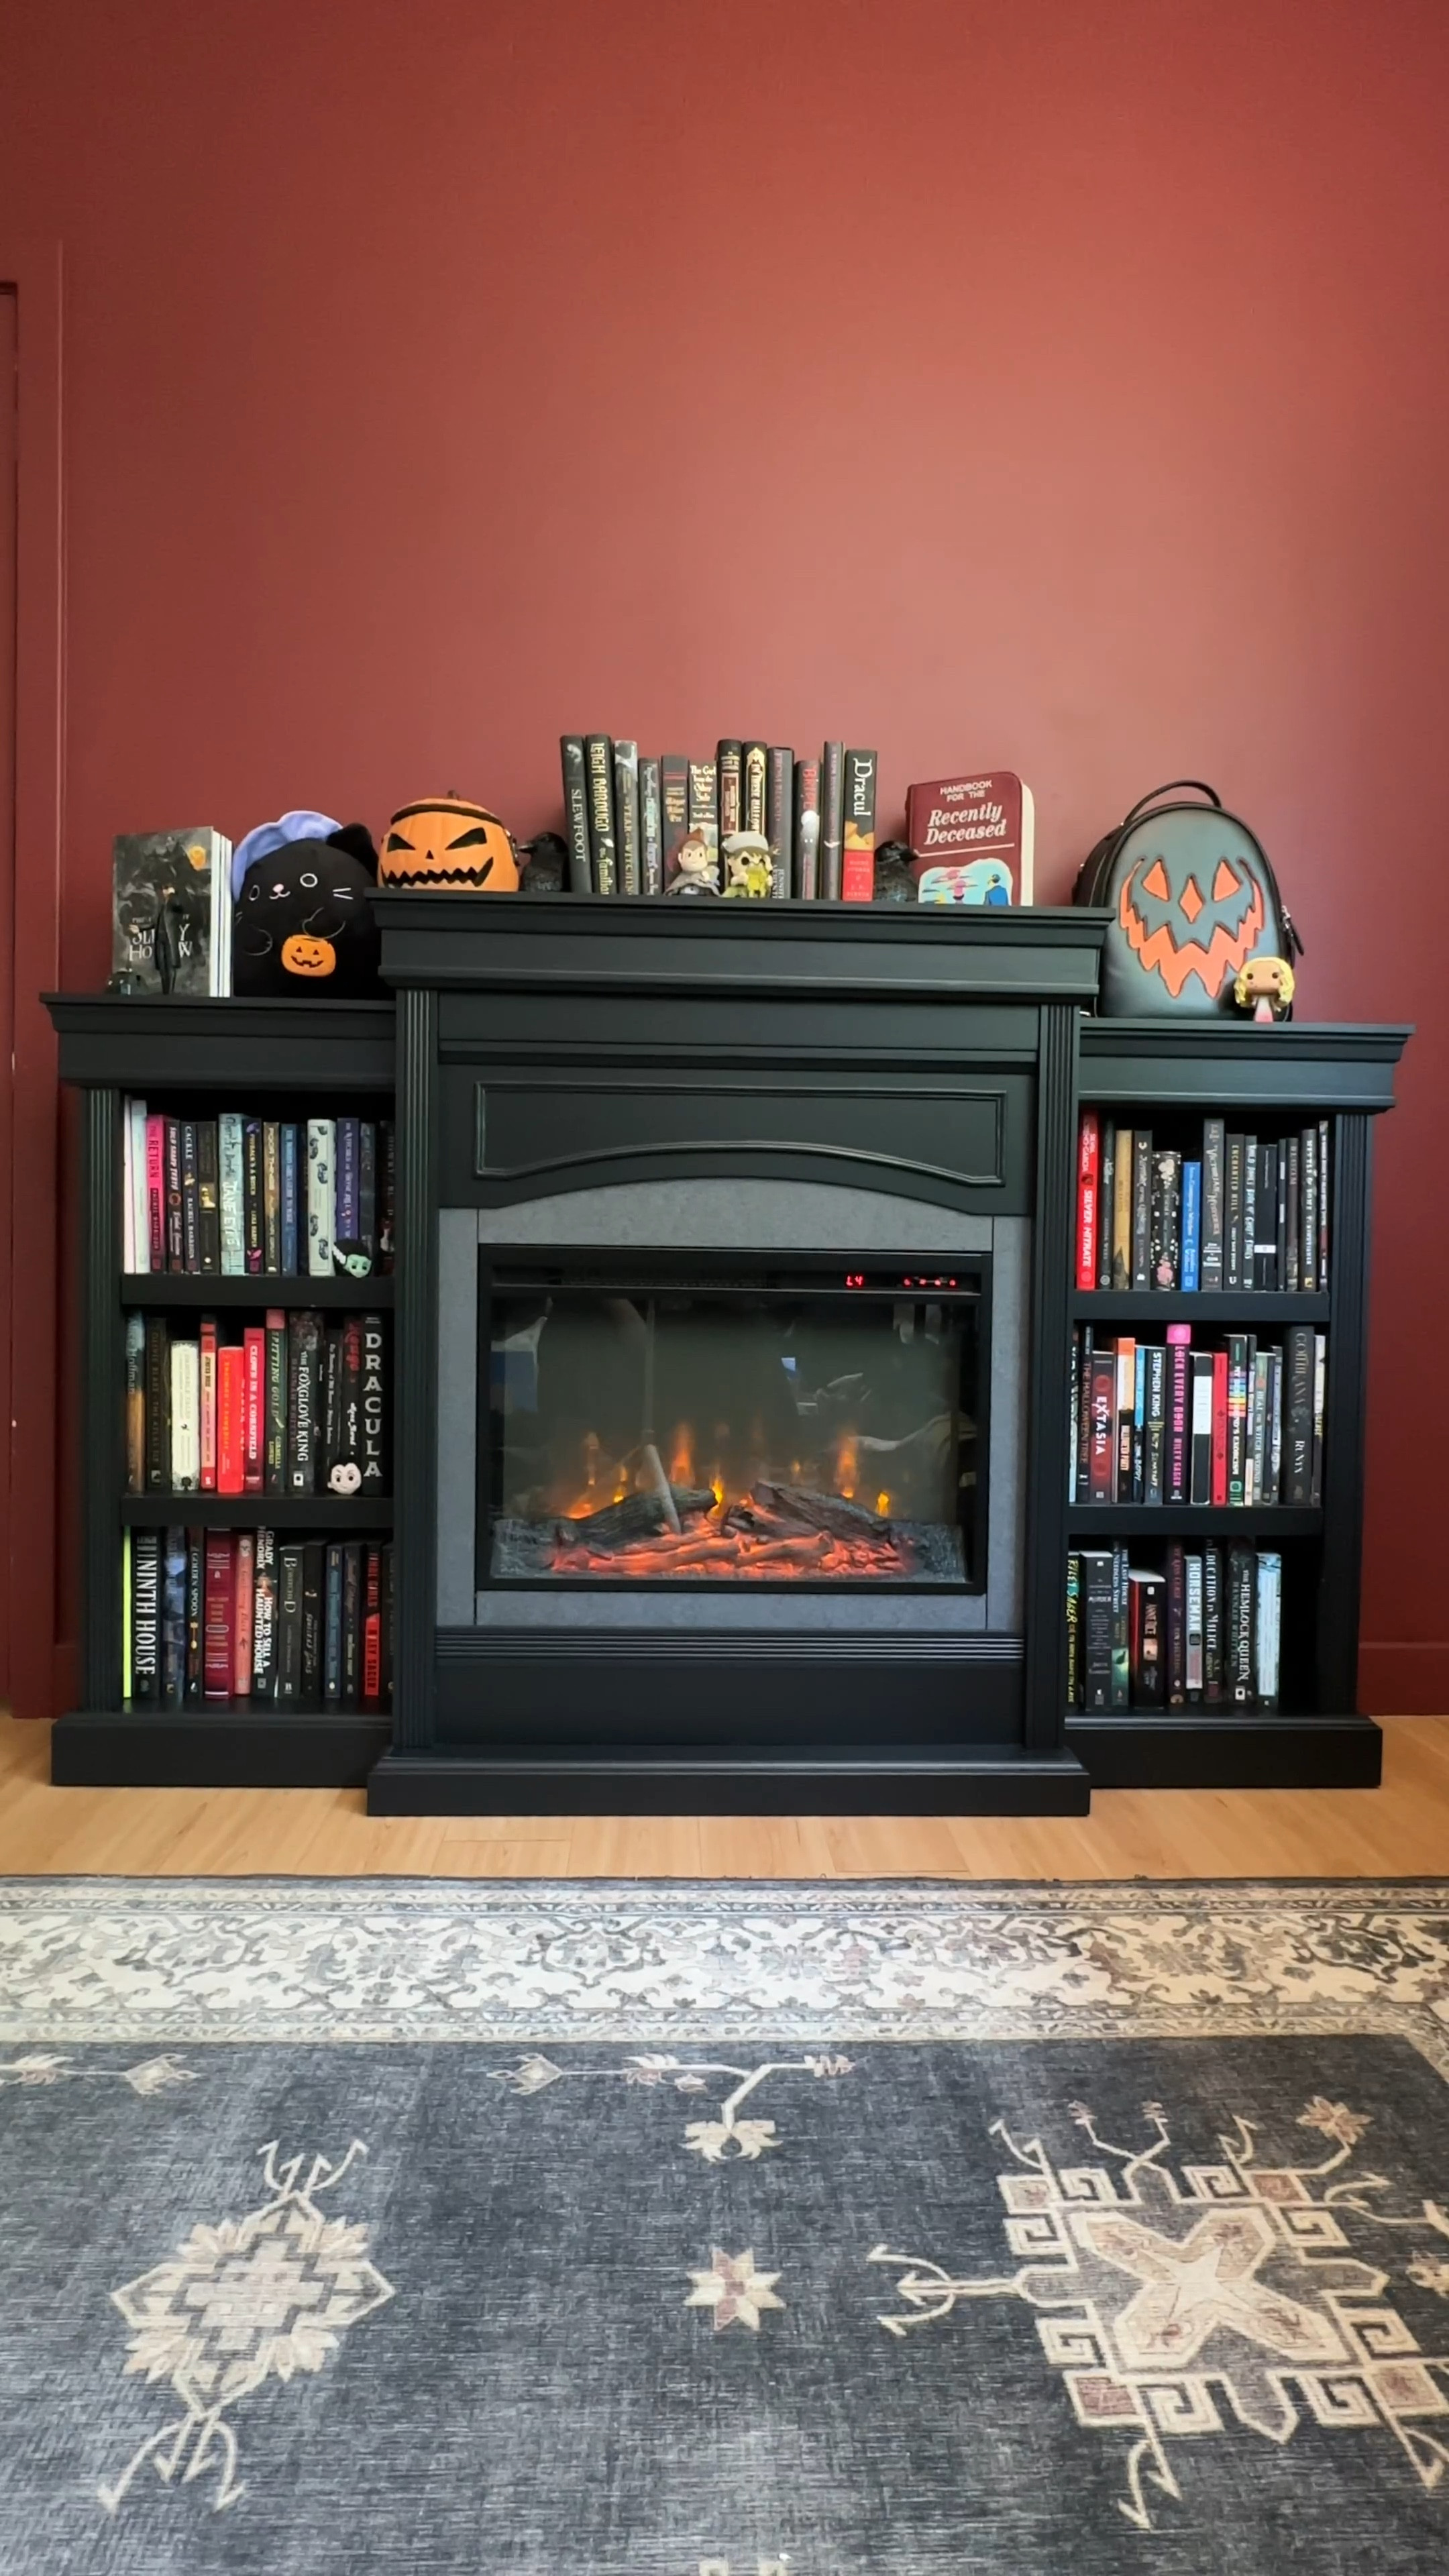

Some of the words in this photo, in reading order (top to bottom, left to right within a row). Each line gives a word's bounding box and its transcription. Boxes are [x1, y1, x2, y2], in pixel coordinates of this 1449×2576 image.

[590, 743, 606, 774] LEIGH
[751, 764, 760, 773] IN
[853, 758, 873, 815] Dracul
[940, 780, 992, 795] HANDBOOK
[947, 792, 963, 802] FOR
[969, 790, 985, 798] THE
[594, 778, 610, 832] BARDUGO
[751, 799, 760, 833] HALLOW
[927, 802, 1002, 827] Recently
[571, 789, 585, 861] SLEWFOOT
[924, 818, 1007, 845] Deceased
[169, 1146, 178, 1166] SHARP
[184, 1126, 193, 1160] CACKLE
[148, 1140, 160, 1178] RETURN
[268, 1157, 276, 1190] THINGS
[1231, 1145, 1240, 1190] ENCHANTED
[186, 1197, 195, 1223] RACHEL
[221, 1181, 238, 1212] JANE
[1083, 1189, 1093, 1223] SILVER
[1230, 1193, 1239, 1212] HILL
[187, 1226, 195, 1259] HARRISON
[250, 1226, 258, 1247] HARPER
[1082, 1226, 1093, 1267] NITRATE
[127, 1348, 138, 1394] Hoffman
[249, 1345, 258, 1379] CLOWN
[271, 1331, 280, 1382] SPITTING
[1083, 1362, 1092, 1380] THE
[1152, 1352, 1162, 1391] STEPHEN
[1175, 1346, 1185, 1369] LOCK
[250, 1381, 258, 1391] IN
[250, 1393, 258, 1402] A
[297, 1366, 311, 1428] FOXGLOVE
[1174, 1373, 1184, 1403] EVERY
[1256, 1391, 1264, 1411] HEAL
[271, 1387, 280, 1418] GOLD
[363, 1332, 384, 1478] DRACULA
[1079, 1382, 1091, 1441] HALLOWEEN
[1151, 1394, 1161, 1417] KING
[248, 1403, 258, 1460] CORNFIELD
[1091, 1396, 1110, 1455] EXTASIA
[1173, 1407, 1184, 1432] DOOR
[296, 1430, 309, 1462] KING
[1173, 1438, 1182, 1460] RILEY
[1254, 1425, 1263, 1450] WITCH
[1079, 1443, 1088, 1464] TREE
[1232, 1436, 1240, 1475] EXORCISM
[1253, 1453, 1261, 1483] WOUND
[1134, 1459, 1142, 1482] BODY
[1173, 1462, 1181, 1486] SAGER
[256, 1527, 265, 1569] HENDRIX
[265, 1531, 274, 1565] GRADY
[1067, 1558, 1079, 1590] RILEY
[1113, 1554, 1122, 1587] NEEDLESS
[1121, 1563, 1130, 1579] LAST
[136, 1560, 158, 1613] NINTH
[1112, 1589, 1121, 1613] STREET
[1120, 1582, 1130, 1605] HOUSE
[1189, 1562, 1201, 1631] HORSEMAN
[191, 1588, 199, 1617] SPOON
[254, 1589, 265, 1639] HAUNTED
[263, 1597, 272, 1619] HOW
[1066, 1591, 1079, 1623] SAGER
[1238, 1583, 1251, 1639] HEMLOCK
[263, 1623, 271, 1635] TO
[1144, 1621, 1157, 1635] RICE
[1206, 1614, 1220, 1650] MALICE
[135, 1619, 156, 1675] HOUSE
[254, 1640, 263, 1674] HOUSE
[262, 1638, 272, 1658] SELL
[1237, 1640, 1251, 1682] QUEEN
[262, 1660, 270, 1668] A
